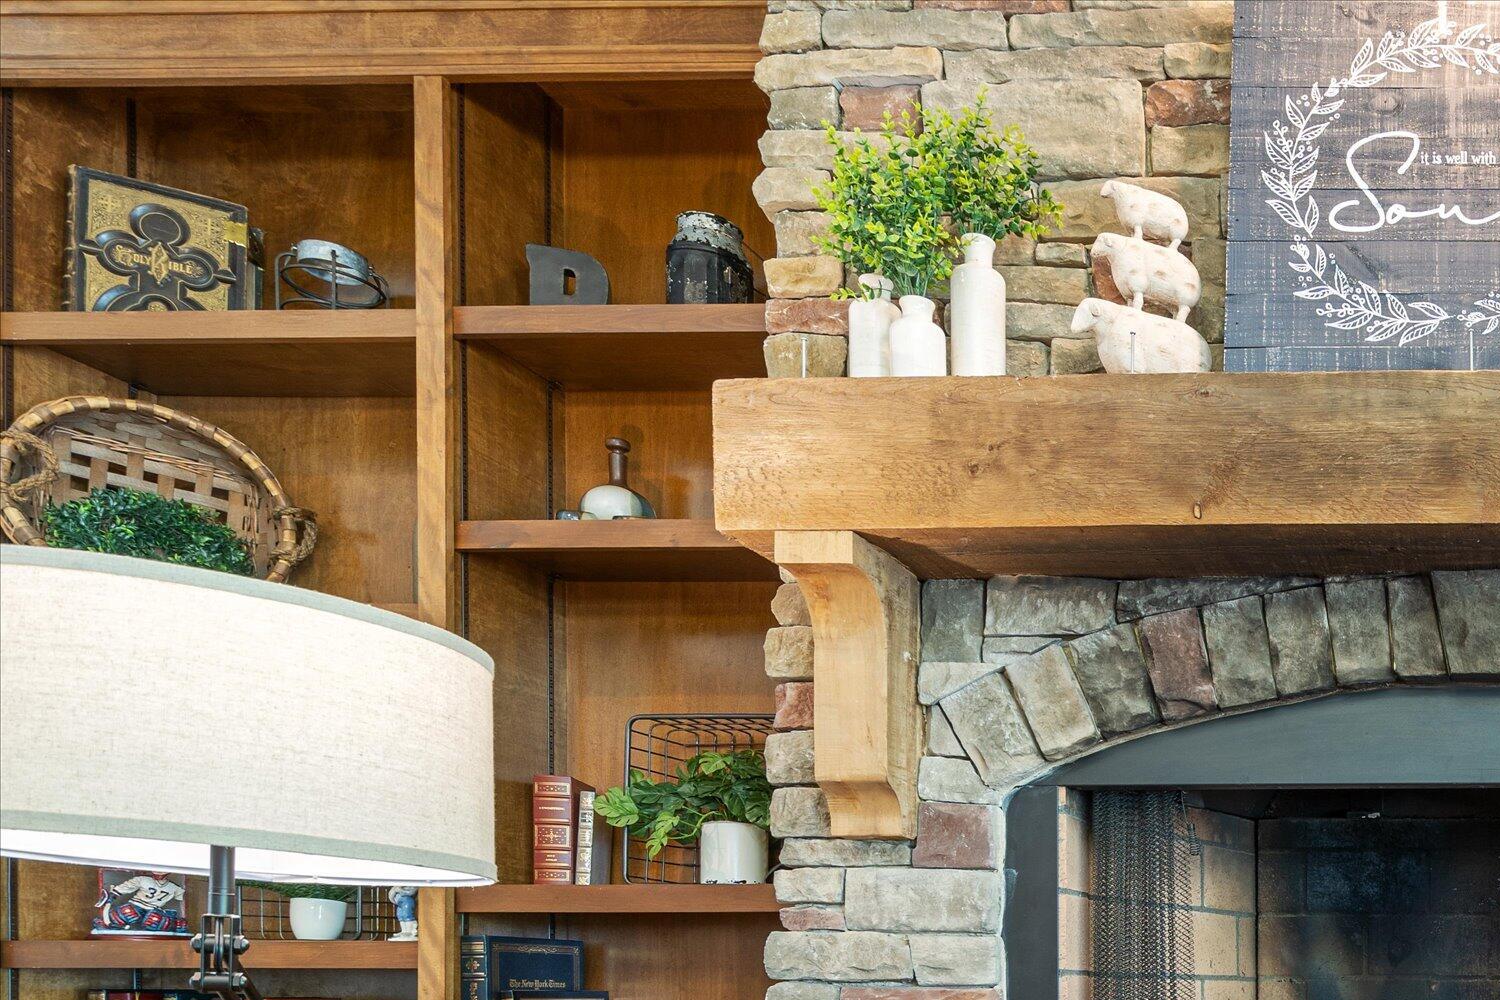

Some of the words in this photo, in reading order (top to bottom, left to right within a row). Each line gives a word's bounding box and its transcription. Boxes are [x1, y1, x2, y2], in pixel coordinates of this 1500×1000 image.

[1420, 150, 1429, 166] it
[1432, 150, 1442, 164] is
[1445, 150, 1468, 165] well
[1471, 150, 1496, 166] with
[145, 887, 169, 901] 37
[521, 979, 535, 988] New
[549, 979, 566, 988] Times
